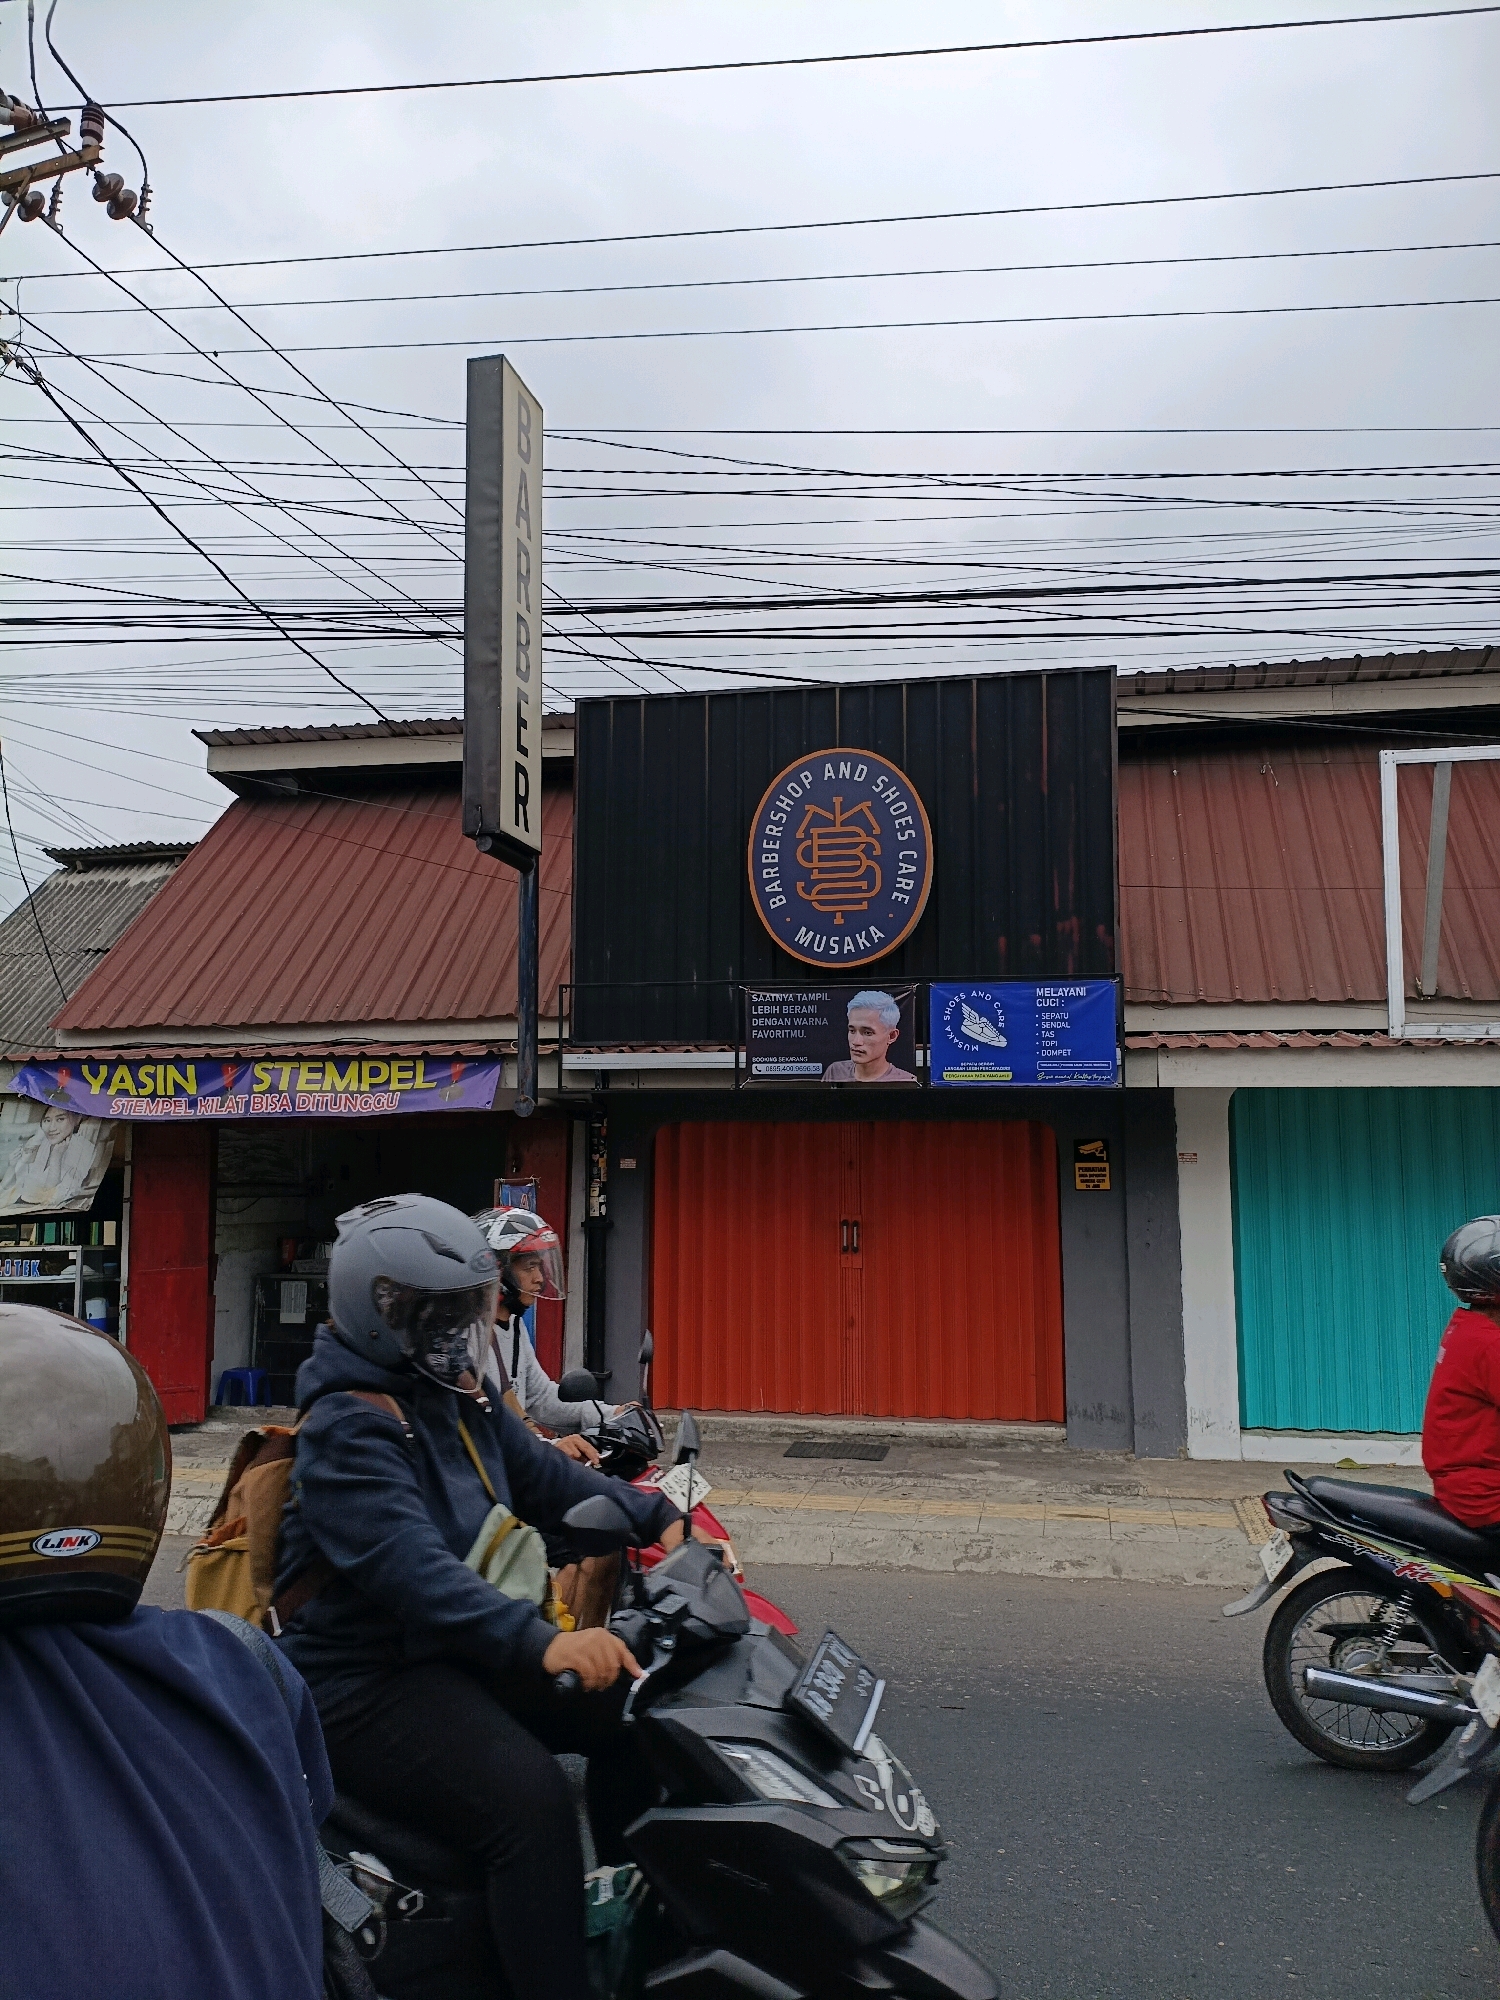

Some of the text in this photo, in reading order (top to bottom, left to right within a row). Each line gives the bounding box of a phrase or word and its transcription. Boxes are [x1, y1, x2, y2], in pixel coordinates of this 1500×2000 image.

[514, 391, 531, 834] BARBER
[823, 762, 868, 782] AND
[871, 775, 916, 841] SHOES
[762, 770, 813, 909] BARBERSHOP
[891, 850, 918, 904] CARE
[794, 925, 885, 954] MUSAKA
[752, 993, 831, 1002] SAATNYA TAMPIL
[1036, 987, 1087, 997] MELAYANI
[752, 1005, 817, 1014] LEBIH BERANI
[1036, 999, 1059, 1007] CUCI
[752, 1017, 829, 1026] DENGAN WARNA
[943, 990, 1005, 1051] MUSAKA SHOES AND CARE
[1041, 1021, 1071, 1029] SENDAL
[752, 1029, 807, 1039] FAVORITMU.
[81, 1060, 437, 1096] YASIN STEMPEL
[109, 1092, 400, 1116] STEMPEL KILAT BISA DITUNGGU
[0, 1259, 40, 1277] OTEK
[41, 1535, 93, 1549] LINK
